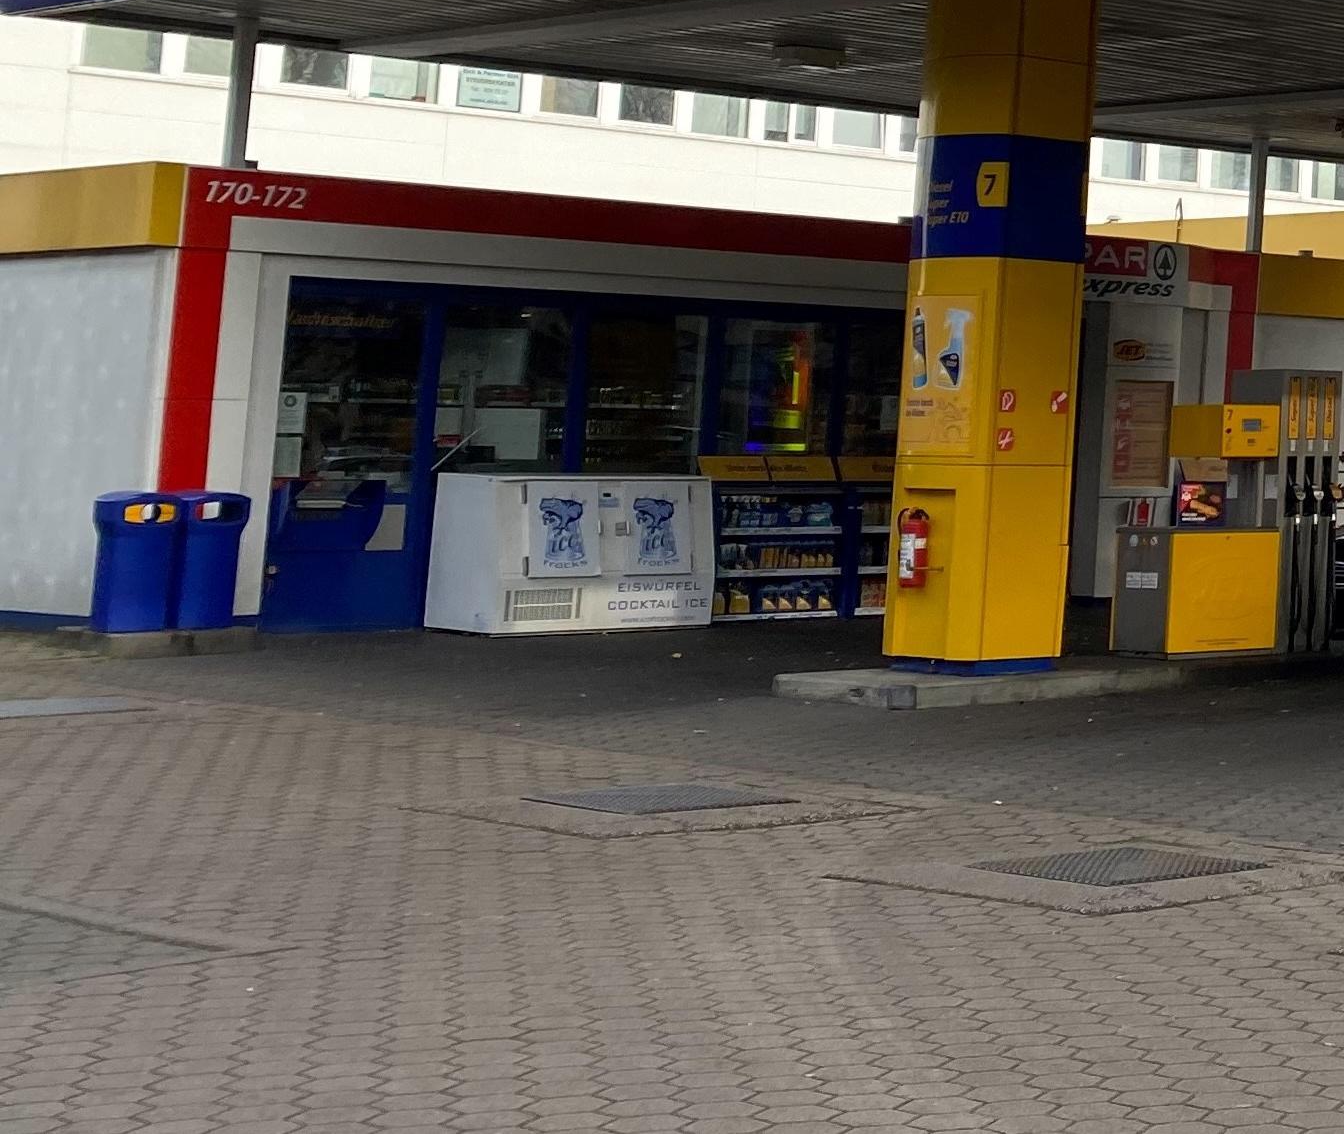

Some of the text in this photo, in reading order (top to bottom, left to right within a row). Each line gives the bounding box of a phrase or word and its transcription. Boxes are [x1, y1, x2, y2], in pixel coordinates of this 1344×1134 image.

[983, 174, 997, 196] 7
[205, 180, 308, 209] 170-172
[949, 211, 969, 224] E10
[1084, 277, 1175, 298] xpress
[617, 578, 701, 593] EISWÜRFEL
[607, 597, 708, 611] COCKTAIL ICE
